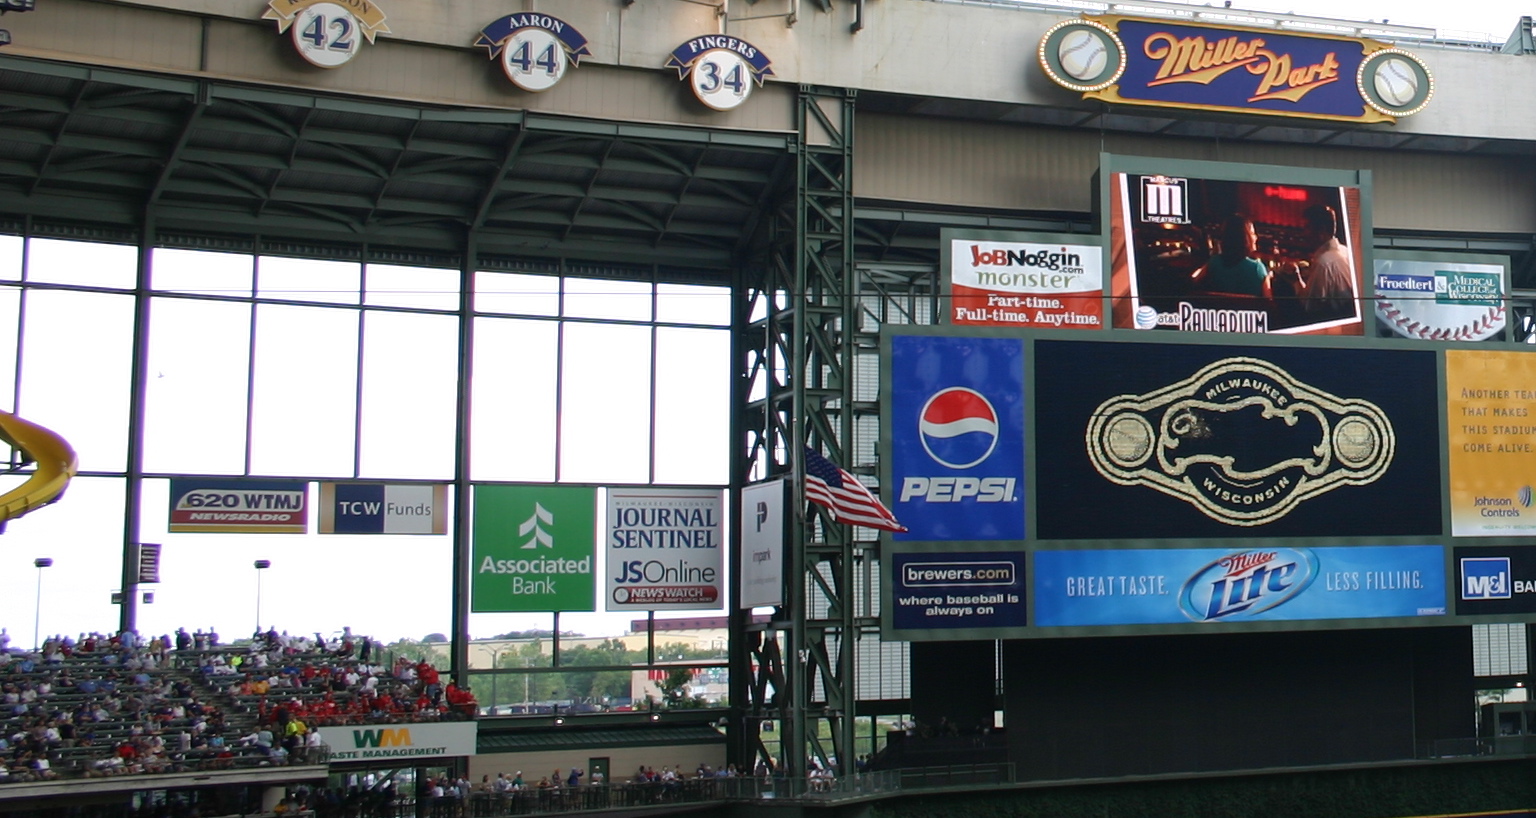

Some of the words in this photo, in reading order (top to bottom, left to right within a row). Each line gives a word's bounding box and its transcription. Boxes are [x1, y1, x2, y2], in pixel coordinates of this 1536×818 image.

[302, 15, 355, 52] 42
[510, 16, 564, 34] AARON
[690, 37, 757, 59] FINGERS
[511, 41, 560, 75] 44
[1144, 32, 1266, 82] Miller
[1246, 50, 1339, 97] Park
[701, 62, 747, 95] 34
[975, 271, 1076, 289] monster
[1379, 276, 1433, 290] Froedtert
[1453, 275, 1495, 287] MEDICAL
[988, 294, 1064, 308] Part-time.
[956, 308, 1030, 322] Full-time.
[1034, 311, 1100, 327] Anytime.
[1205, 379, 1288, 406] MILWAUKEE
[1461, 388, 1510, 399] ANOTHER
[1462, 407, 1488, 417] THAT
[1493, 408, 1529, 417] MAKES
[1462, 425, 1488, 434] THIS
[1463, 443, 1492, 453] COME
[1497, 443, 1534, 453] ALIVE.
[1203, 476, 1290, 505] WISCONSIN
[186, 494, 240, 508] 620
[243, 494, 301, 510] WTMJ
[340, 501, 381, 516] TCW
[387, 503, 431, 516] Funds
[1474, 496, 1512, 507] Johnson
[190, 512, 291, 522] NEWSRADIO
[613, 508, 717, 528] JOURNAL
[1480, 507, 1520, 517] Controls
[613, 530, 717, 548] SENTINEL
[480, 556, 590, 574] Associated
[614, 559, 715, 583] JSOnline
[1219, 552, 1278, 575] Miller
[908, 568, 1009, 580] brewers.com
[1326, 572, 1360, 591] LESS
[1366, 570, 1425, 590] FILLING.
[513, 576, 556, 595] Bank
[1067, 576, 1115, 597] GREAT
[1120, 575, 1170, 596] TASTE.
[1204, 562, 1296, 620] Lite
[899, 595, 943, 605] where
[947, 594, 1004, 604] baseball
[1007, 593, 1019, 603] is
[925, 606, 973, 617] always
[976, 606, 994, 615] on
[353, 728, 412, 748] WM
[363, 747, 447, 757] MANAGEMENT
